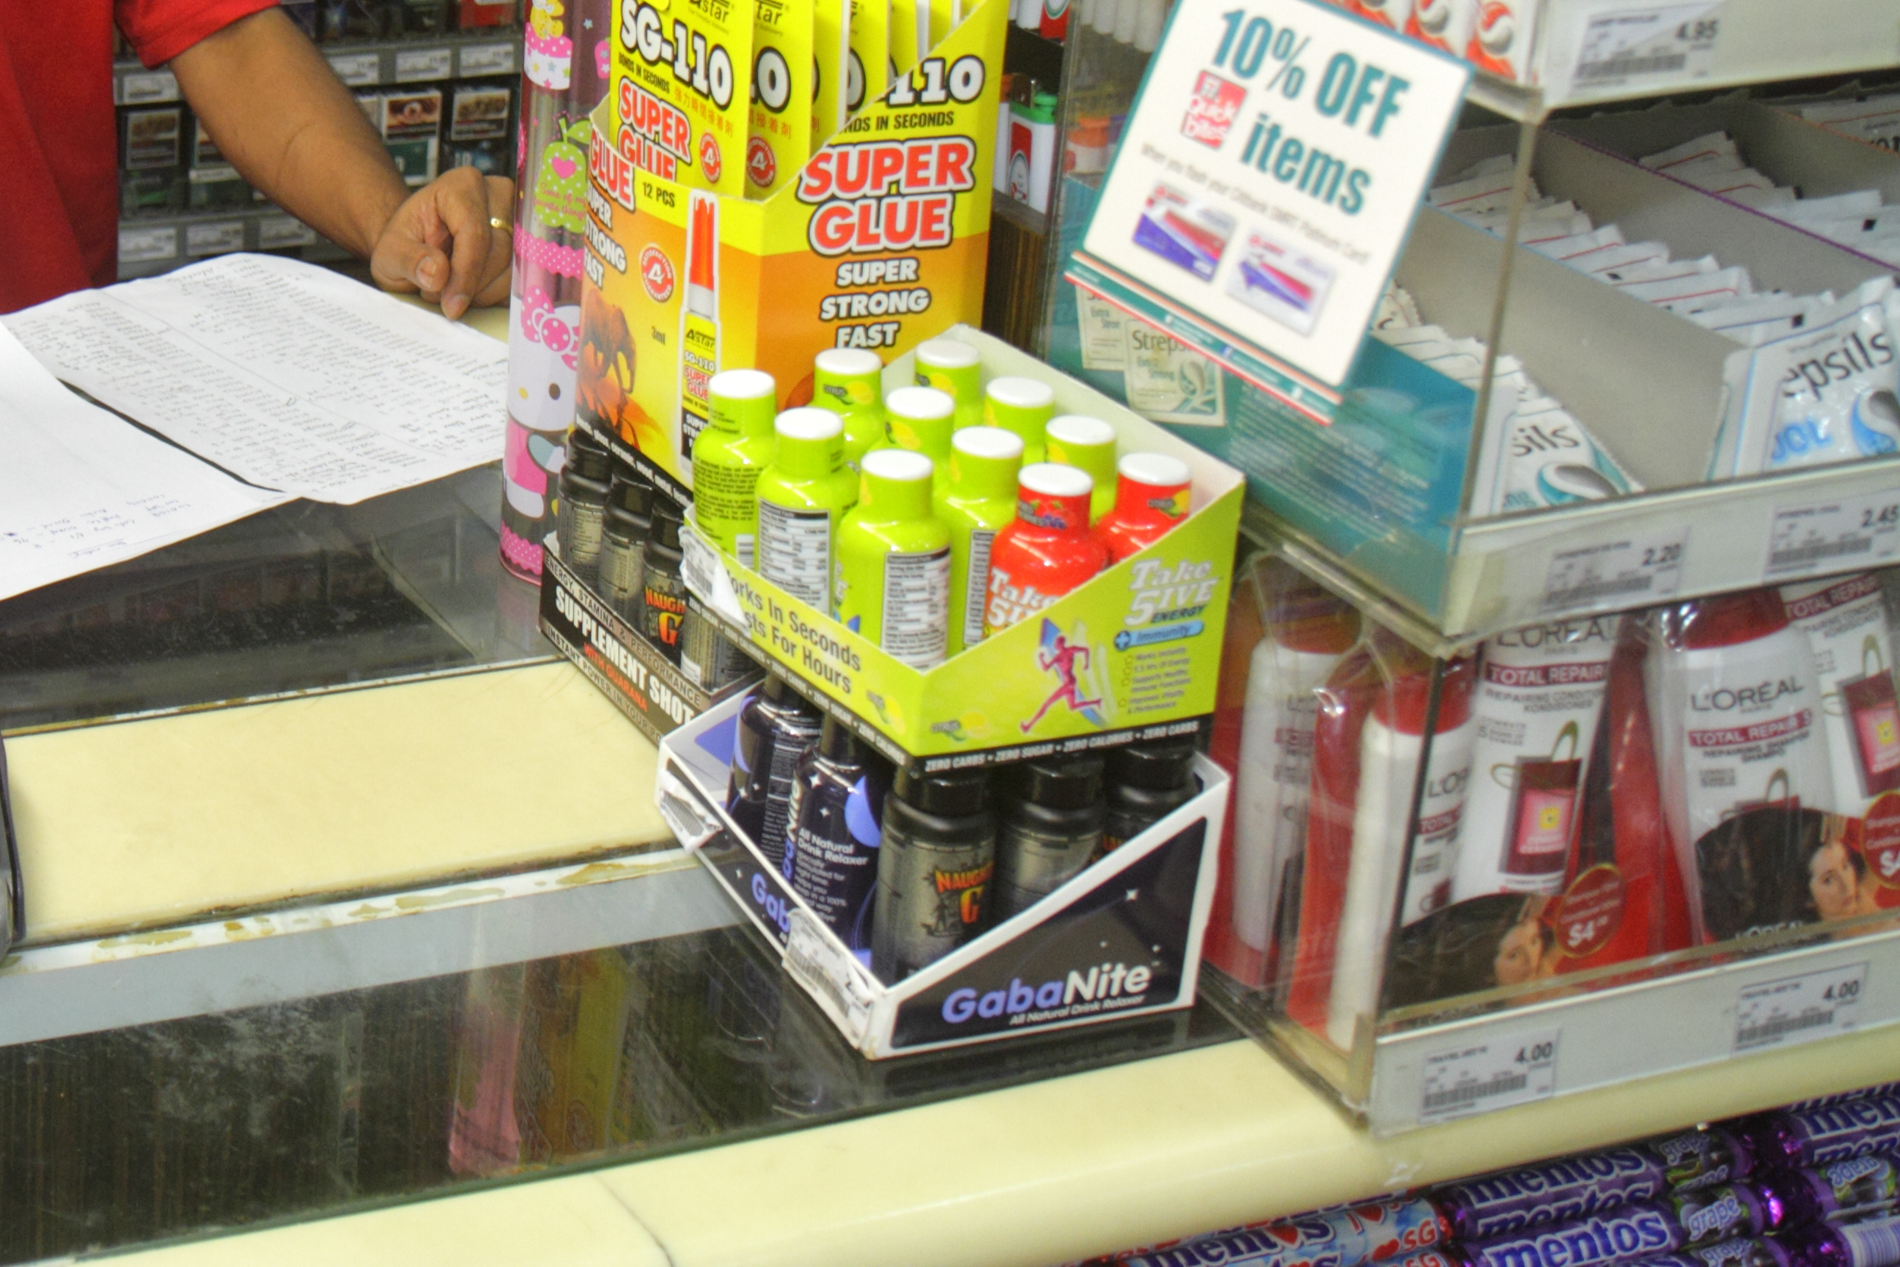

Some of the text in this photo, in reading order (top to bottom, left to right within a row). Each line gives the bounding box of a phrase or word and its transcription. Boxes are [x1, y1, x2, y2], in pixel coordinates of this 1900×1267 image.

[1214, 8, 1410, 137] 10% OFF
[620, 81, 690, 161] SUPER
[875, 110, 955, 131] IN SECONDS
[619, 127, 676, 183] GLUE
[802, 141, 975, 199] SUPER
[1241, 113, 1372, 216] items
[588, 131, 634, 211] GLUE
[812, 197, 953, 252] GLUE
[837, 259, 919, 286] SUPER
[820, 290, 931, 320] STRONG
[836, 322, 899, 349] FAST
[1861, 505, 1900, 527] 2.45
[1643, 544, 1682, 566] 2.20
[1131, 559, 1216, 590] Take
[1152, 605, 1206, 624] ENERGY
[1786, 597, 1830, 620] TOTAL
[729, 576, 862, 673] orks In Seconds
[555, 585, 695, 724] SUPPLEMENT SHOT
[579, 588, 615, 631] STAMINA
[630, 636, 701, 706] PERFORMANCE
[771, 621, 853, 695] For Hours
[1491, 663, 1606, 685] TOTAL REPAIR
[1694, 717, 1799, 747] TOTAL REPAIR
[812, 835, 855, 854] Natural
[825, 848, 869, 866] Relaxer
[942, 961, 1151, 1025] GabaNite
[1823, 980, 1860, 1002] 4.00
[1026, 994, 1145, 1023] Natural Drink Relaxer
[1514, 1041, 1554, 1065] 4.00
[1462, 1147, 1648, 1209] mentos
[1688, 1194, 1741, 1240] grape
[1483, 1211, 1672, 1267] mentos
